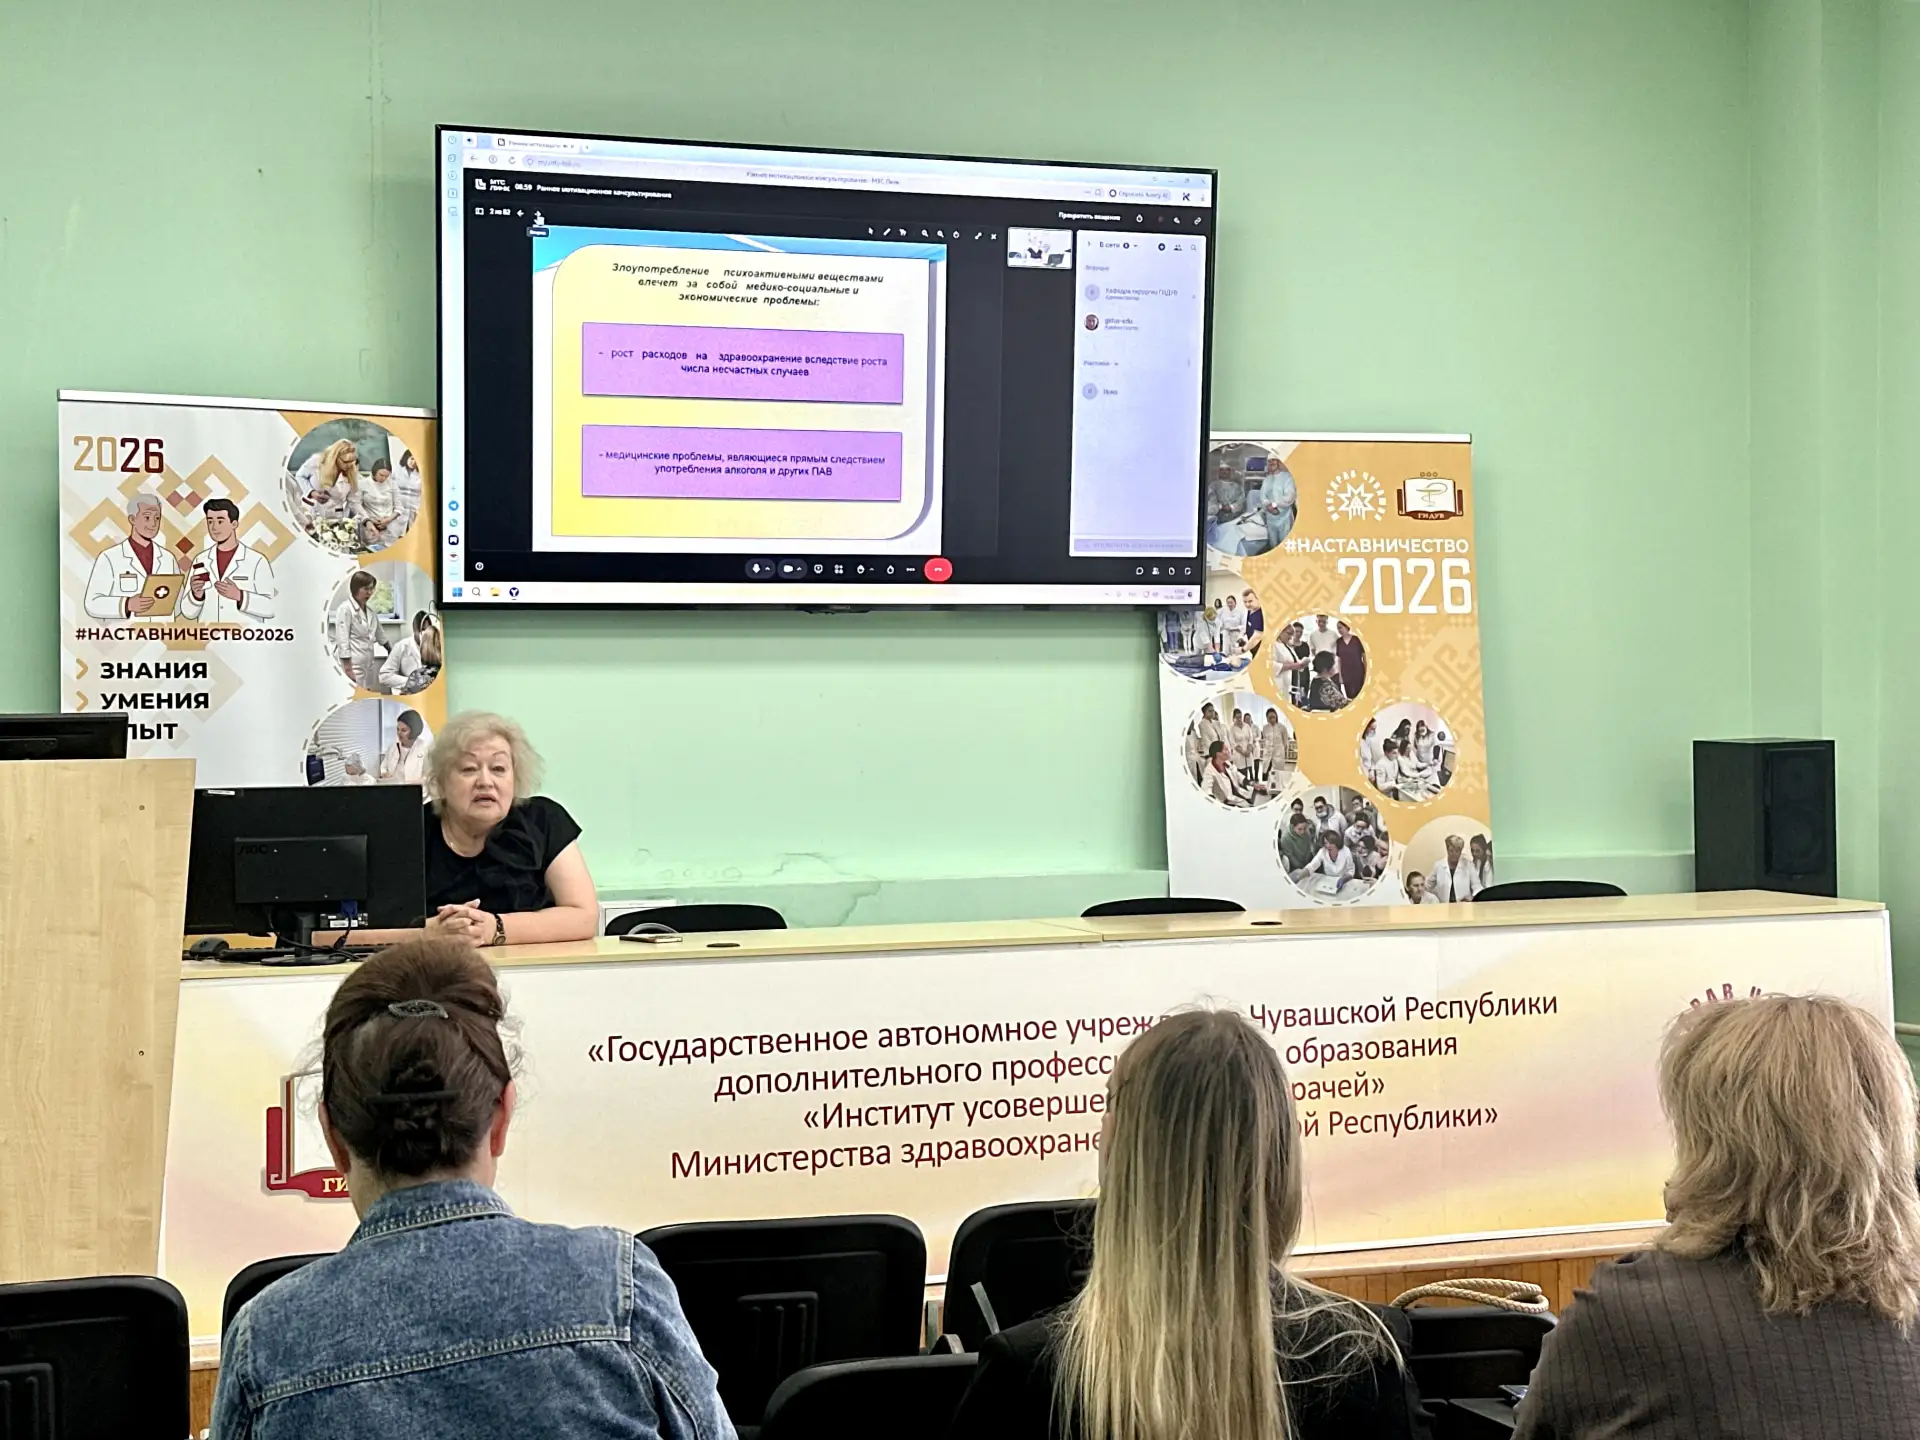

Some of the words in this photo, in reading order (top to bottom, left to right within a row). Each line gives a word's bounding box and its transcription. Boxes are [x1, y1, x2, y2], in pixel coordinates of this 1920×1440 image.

[536, 184, 560, 192] Раннее
[612, 263, 710, 276] Злоупотребление
[723, 268, 815, 281] психоактивными
[817, 272, 884, 284] веществами
[638, 278, 678, 288] влечет
[686, 280, 698, 289] за
[706, 280, 738, 290] собой
[746, 283, 850, 295] медико-социальные
[852, 286, 860, 295] и
[678, 293, 758, 304] экономические
[763, 294, 820, 306] проблемы:
[611, 350, 634, 360] рост
[642, 350, 688, 360] расходов
[696, 352, 708, 360] на
[718, 352, 802, 364] здравоохранение
[804, 355, 859, 366] вследствие
[861, 358, 888, 368] роста
[680, 364, 710, 374] числа
[712, 365, 768, 376] несчастных
[770, 367, 810, 378] случаев
[73, 435, 164, 474] 2026
[605, 450, 670, 462] медицинские
[672, 451, 725, 464] проблемы,
[726, 454, 788, 466] являющиеся
[790, 455, 828, 466] прямым
[830, 455, 886, 466] следствием
[654, 464, 722, 476] употребления
[724, 466, 767, 476] алкоголя
[769, 466, 776, 475] и
[778, 466, 810, 477] других
[811, 466, 832, 476] ПАВ
[1285, 538, 1469, 554] #НАСТАВНИЧЕСТВО
[1336, 557, 1472, 614] 2026
[75, 627, 294, 642] #НАСТАВНИЧЕСТВО2026
[100, 662, 208, 680] ЗНАНИЯ
[100, 692, 210, 710] УМЕНИЯ
[128, 722, 178, 740] ПЫТ
[588, 1024, 868, 1066] «Государственное
[877, 1018, 1058, 1048] автономное
[1065, 1015, 1172, 1045] учреж
[1250, 996, 1396, 1034] Чувашской
[1405, 990, 1558, 1026] Республики
[714, 1058, 983, 1102] дополнительного
[991, 1050, 1118, 1091] професс
[1285, 1034, 1458, 1069] образования
[804, 1098, 956, 1130] «Институт
[962, 1092, 1106, 1127] усоверше
[1291, 1070, 1385, 1101] рачей»
[671, 1144, 892, 1180] Министерства
[1329, 1103, 1498, 1138] Республики»
